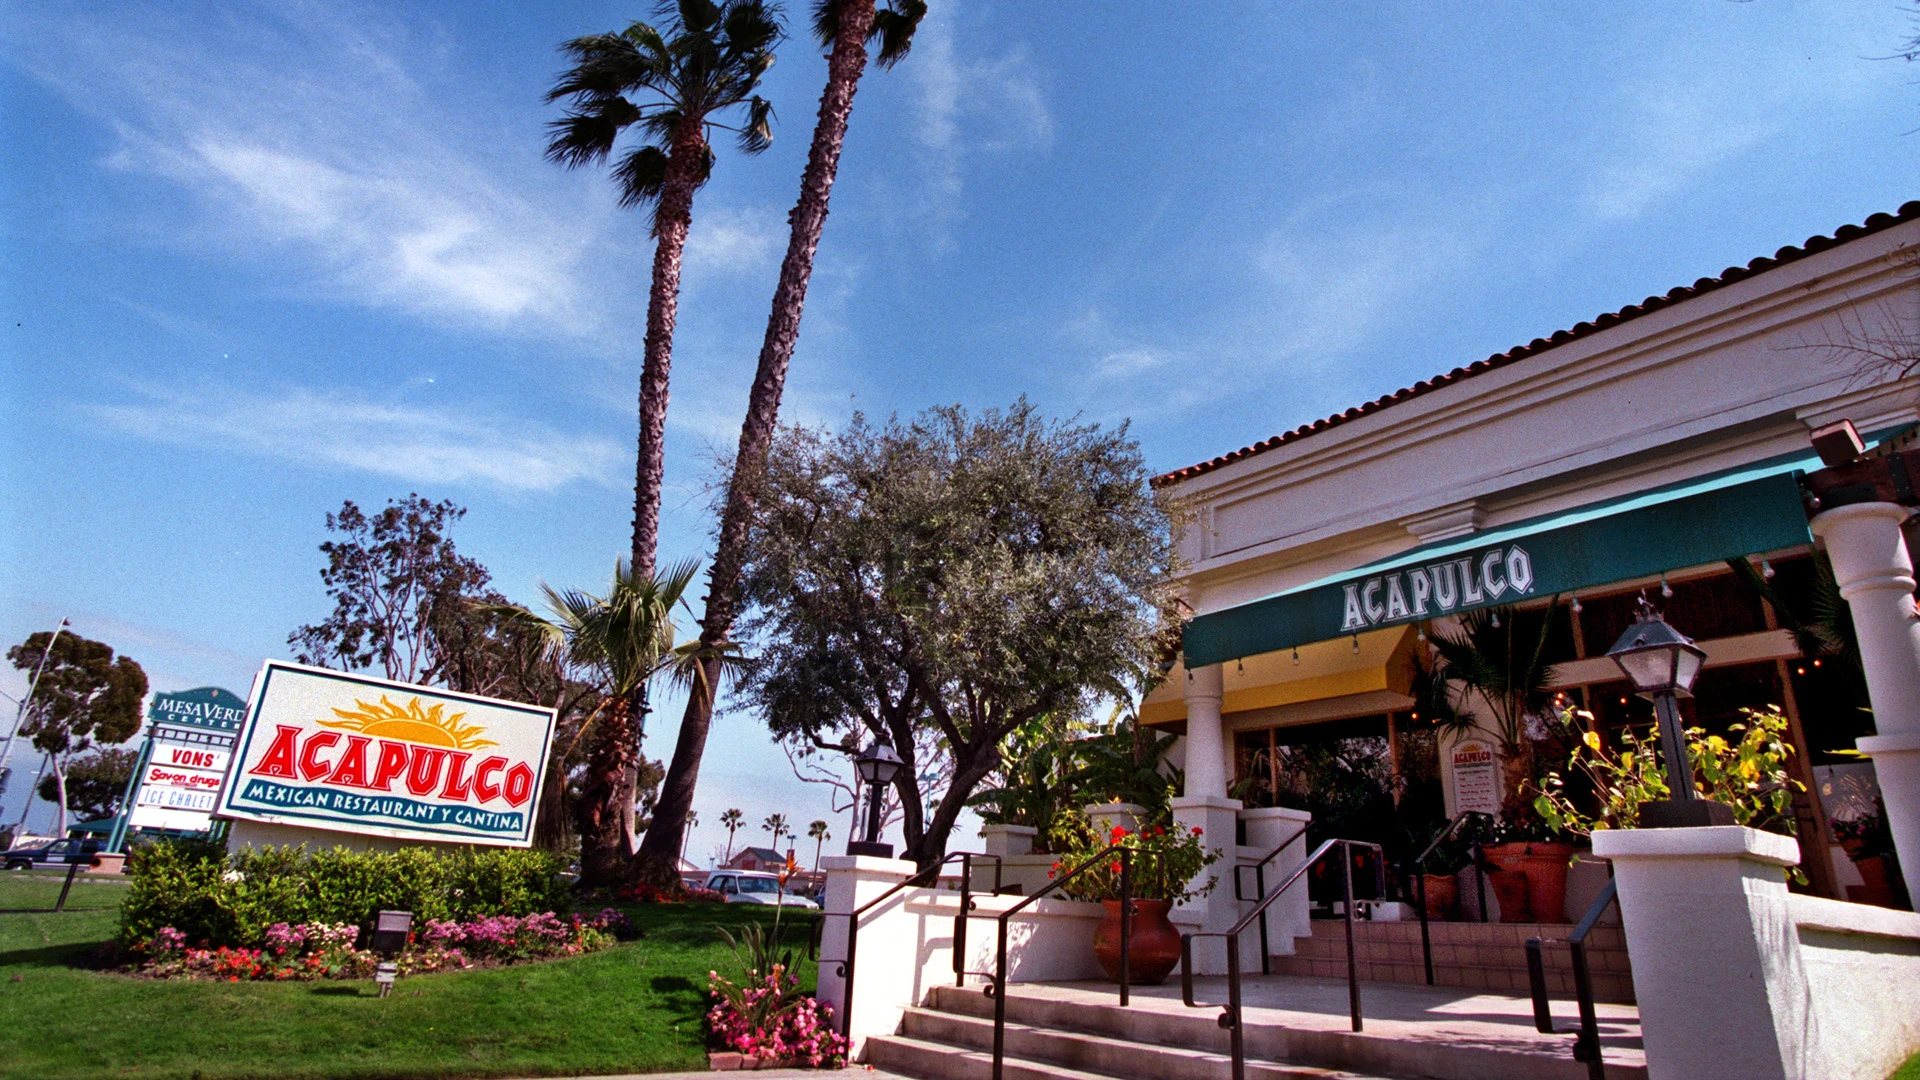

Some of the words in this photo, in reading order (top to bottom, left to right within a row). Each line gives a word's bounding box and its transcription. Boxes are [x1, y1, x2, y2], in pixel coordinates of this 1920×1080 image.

[1340, 544, 1534, 631] ACAPULCO
[167, 713, 240, 729] CENTER
[172, 748, 215, 767] VONS
[248, 724, 535, 808] ACAPULCO
[1454, 751, 1491, 763] ACAPULCO
[189, 775, 221, 788] drugs
[144, 788, 164, 804] ICE
[169, 791, 213, 808] CHALET
[248, 784, 329, 806] MEXICAN
[333, 794, 438, 819] RESTAURANT
[441, 808, 452, 821] Y
[455, 810, 520, 829] CANTINA
